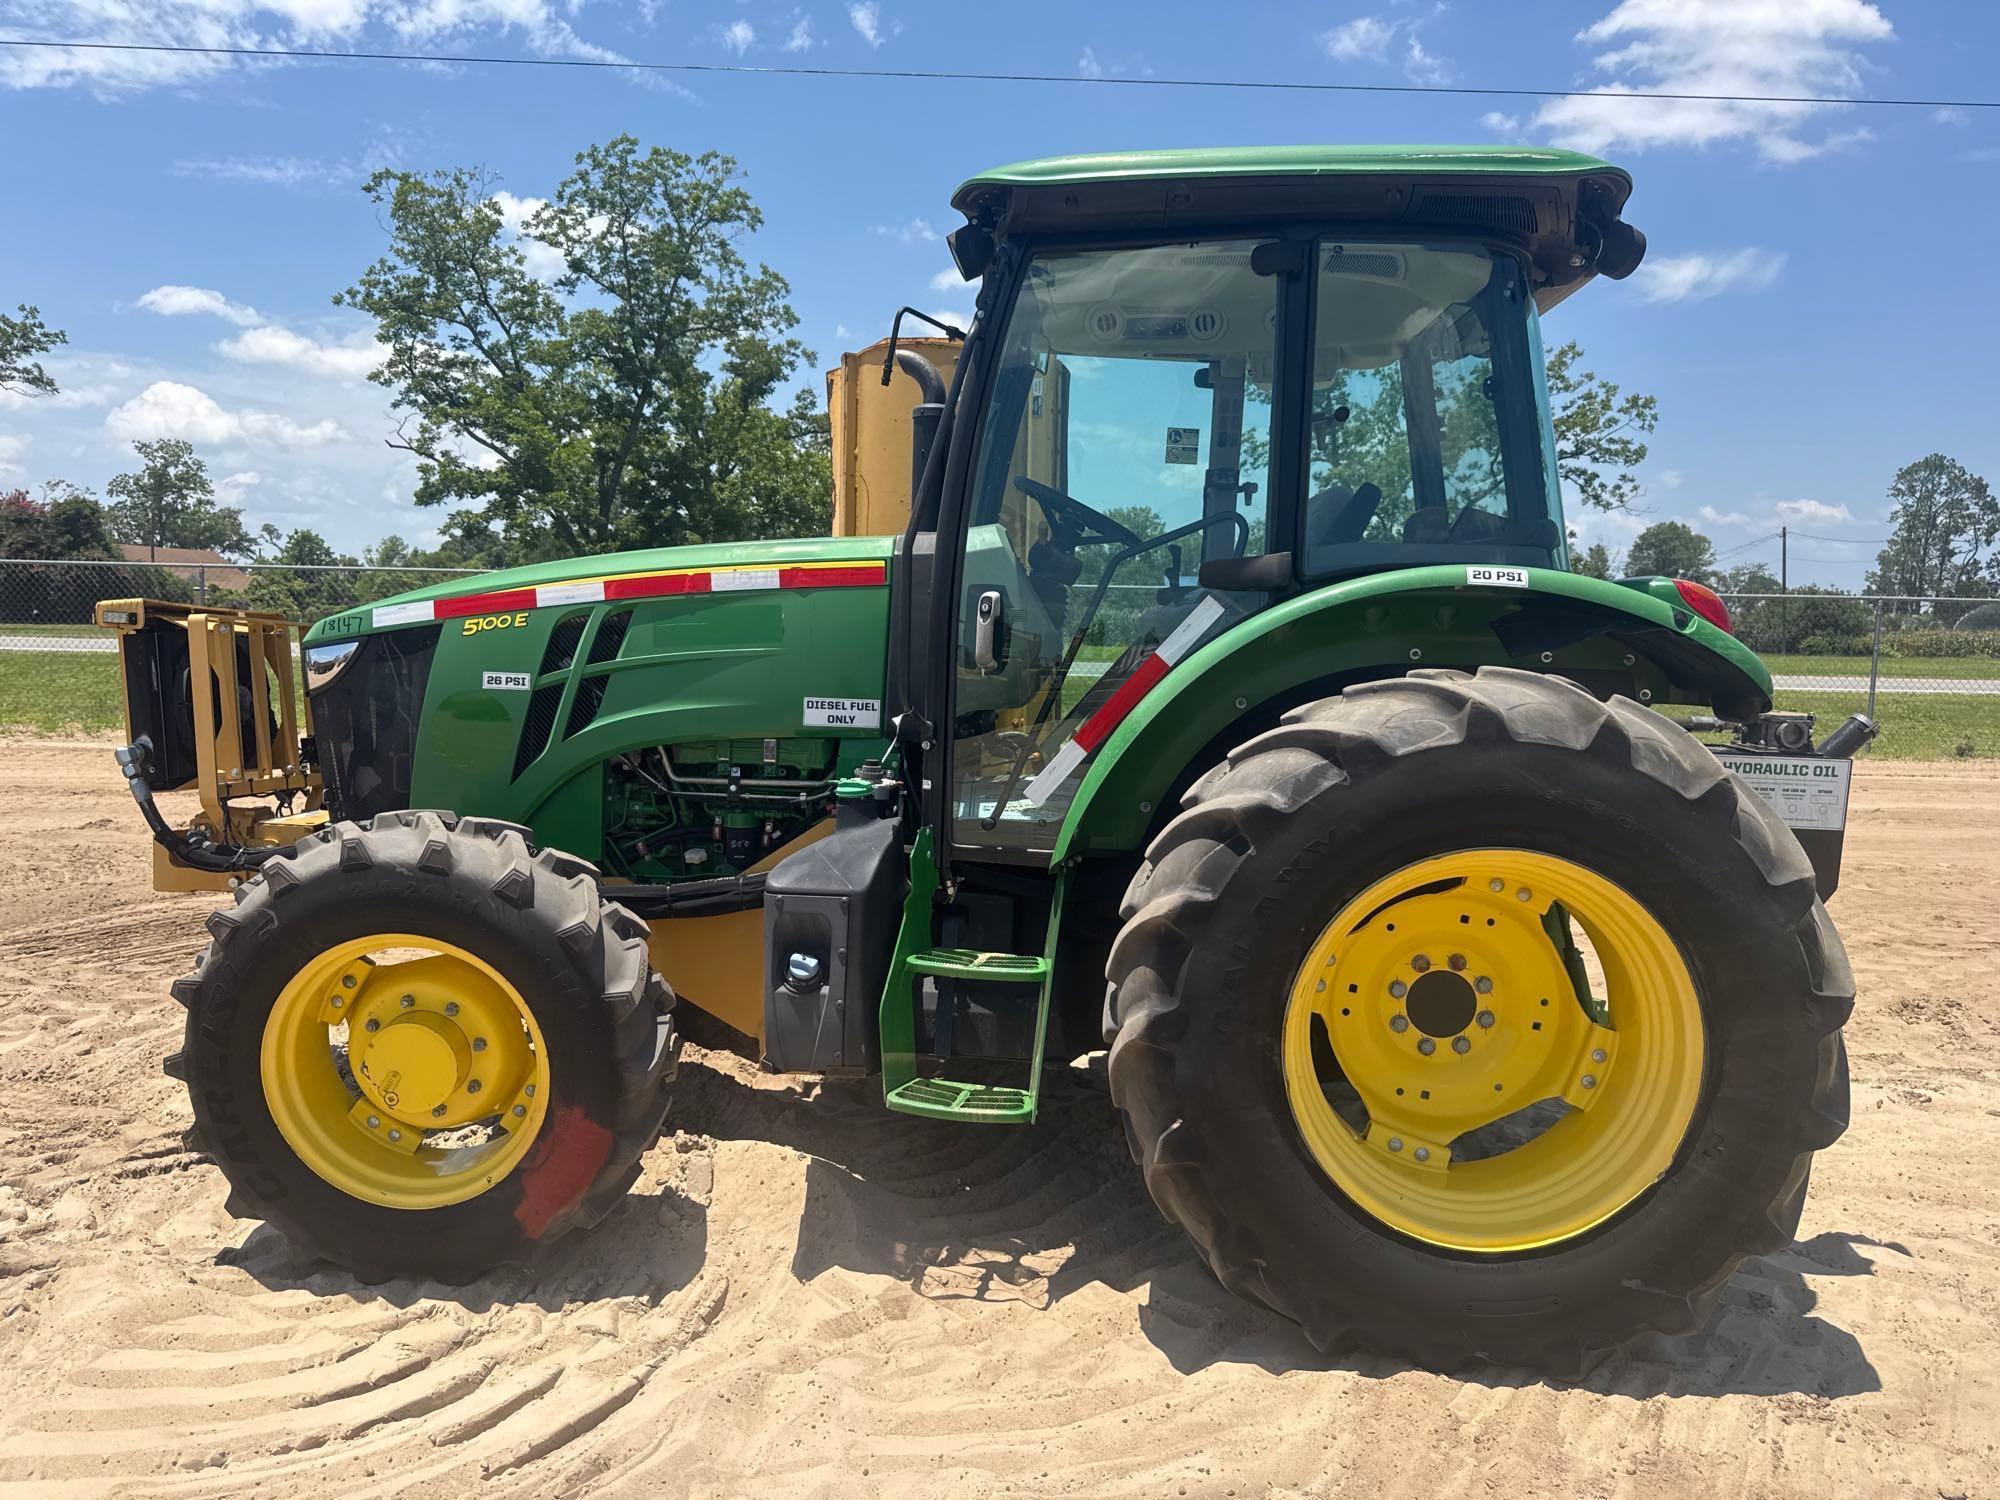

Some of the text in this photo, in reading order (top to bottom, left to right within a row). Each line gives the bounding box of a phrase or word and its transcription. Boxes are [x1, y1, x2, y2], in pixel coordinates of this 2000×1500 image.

[1472, 570, 1523, 582] 20 PSI
[321, 616, 363, 636] 18147
[462, 612, 530, 636] 5100 E
[486, 675, 527, 687] 26 PSI
[806, 700, 878, 712] DIESEL FUEL
[827, 715, 856, 725] ONLY
[1813, 765, 1839, 778] OIL
